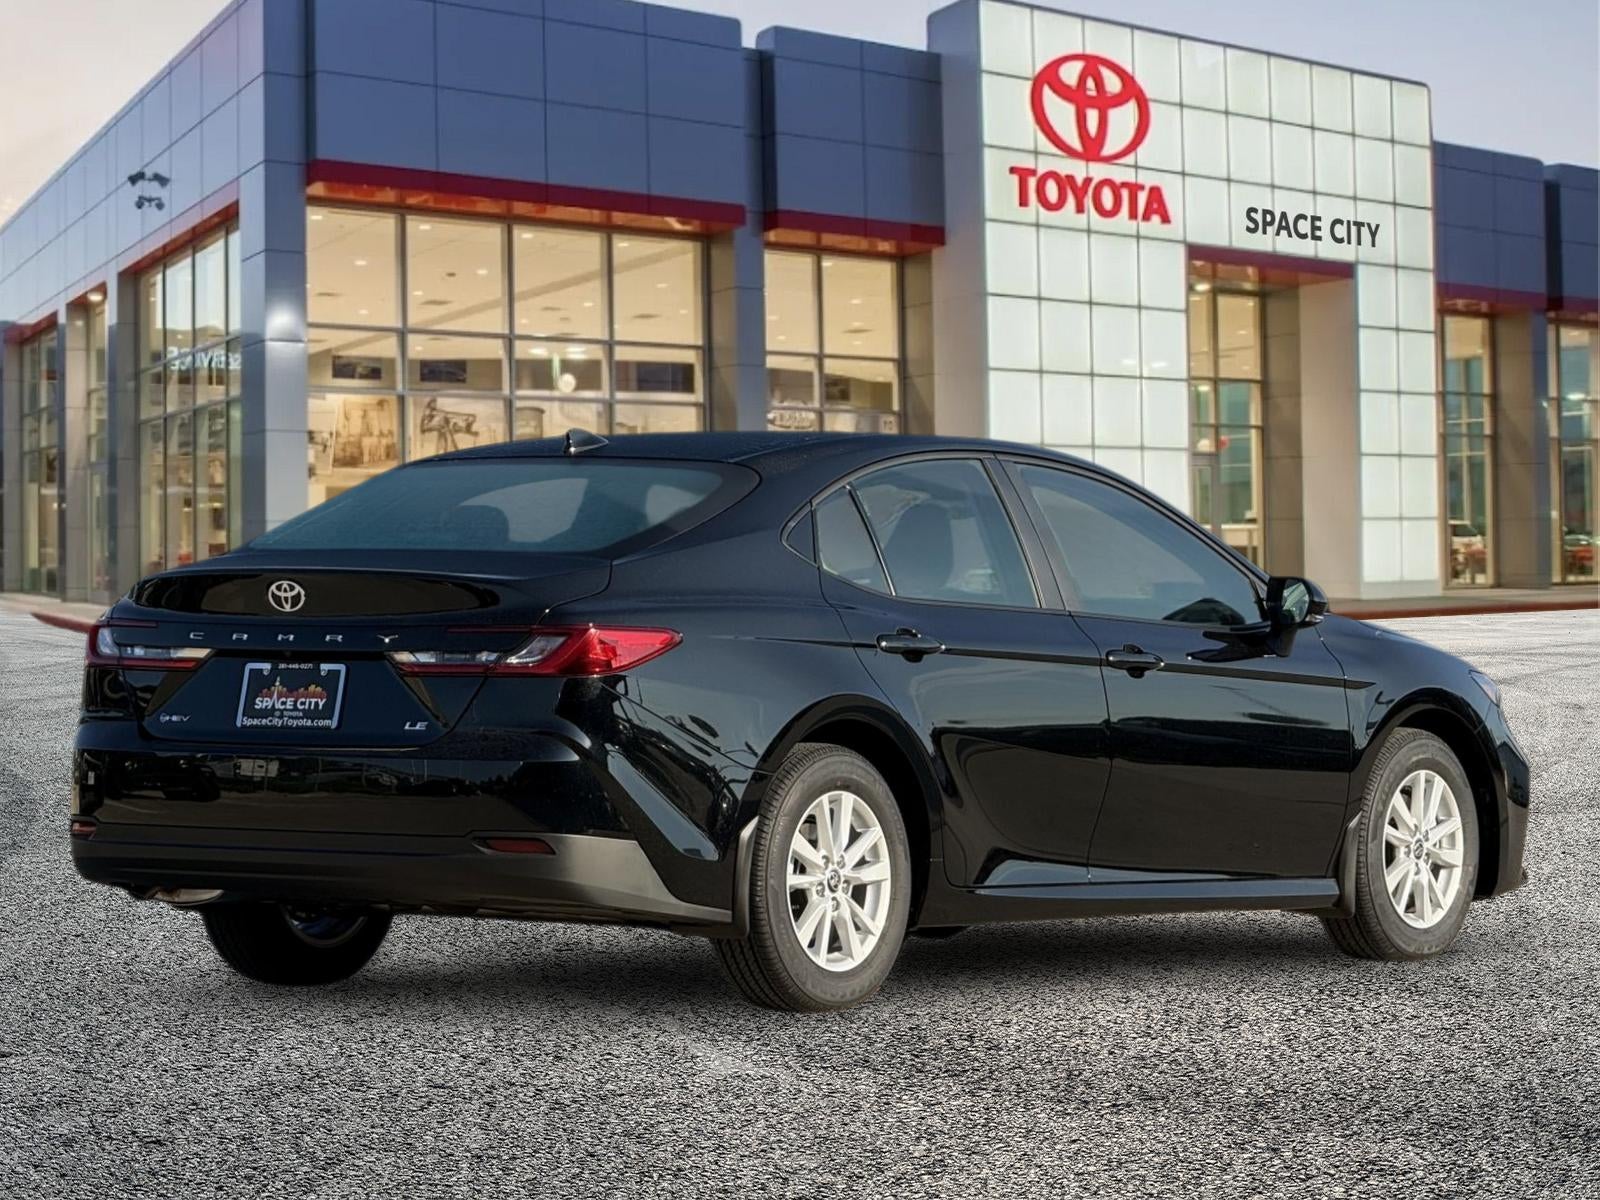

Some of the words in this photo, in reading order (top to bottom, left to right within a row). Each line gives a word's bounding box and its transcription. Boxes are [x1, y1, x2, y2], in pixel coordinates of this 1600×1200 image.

[1009, 166, 1171, 225] TOYOTA
[1245, 206, 1322, 242] SPACE
[1329, 218, 1380, 248] CITY
[189, 631, 399, 643] CAMRY
[254, 697, 295, 709] SPACE
[296, 698, 327, 710] CITY
[242, 716, 332, 727] SpaceCityToyota.com
[404, 721, 429, 730] LE
